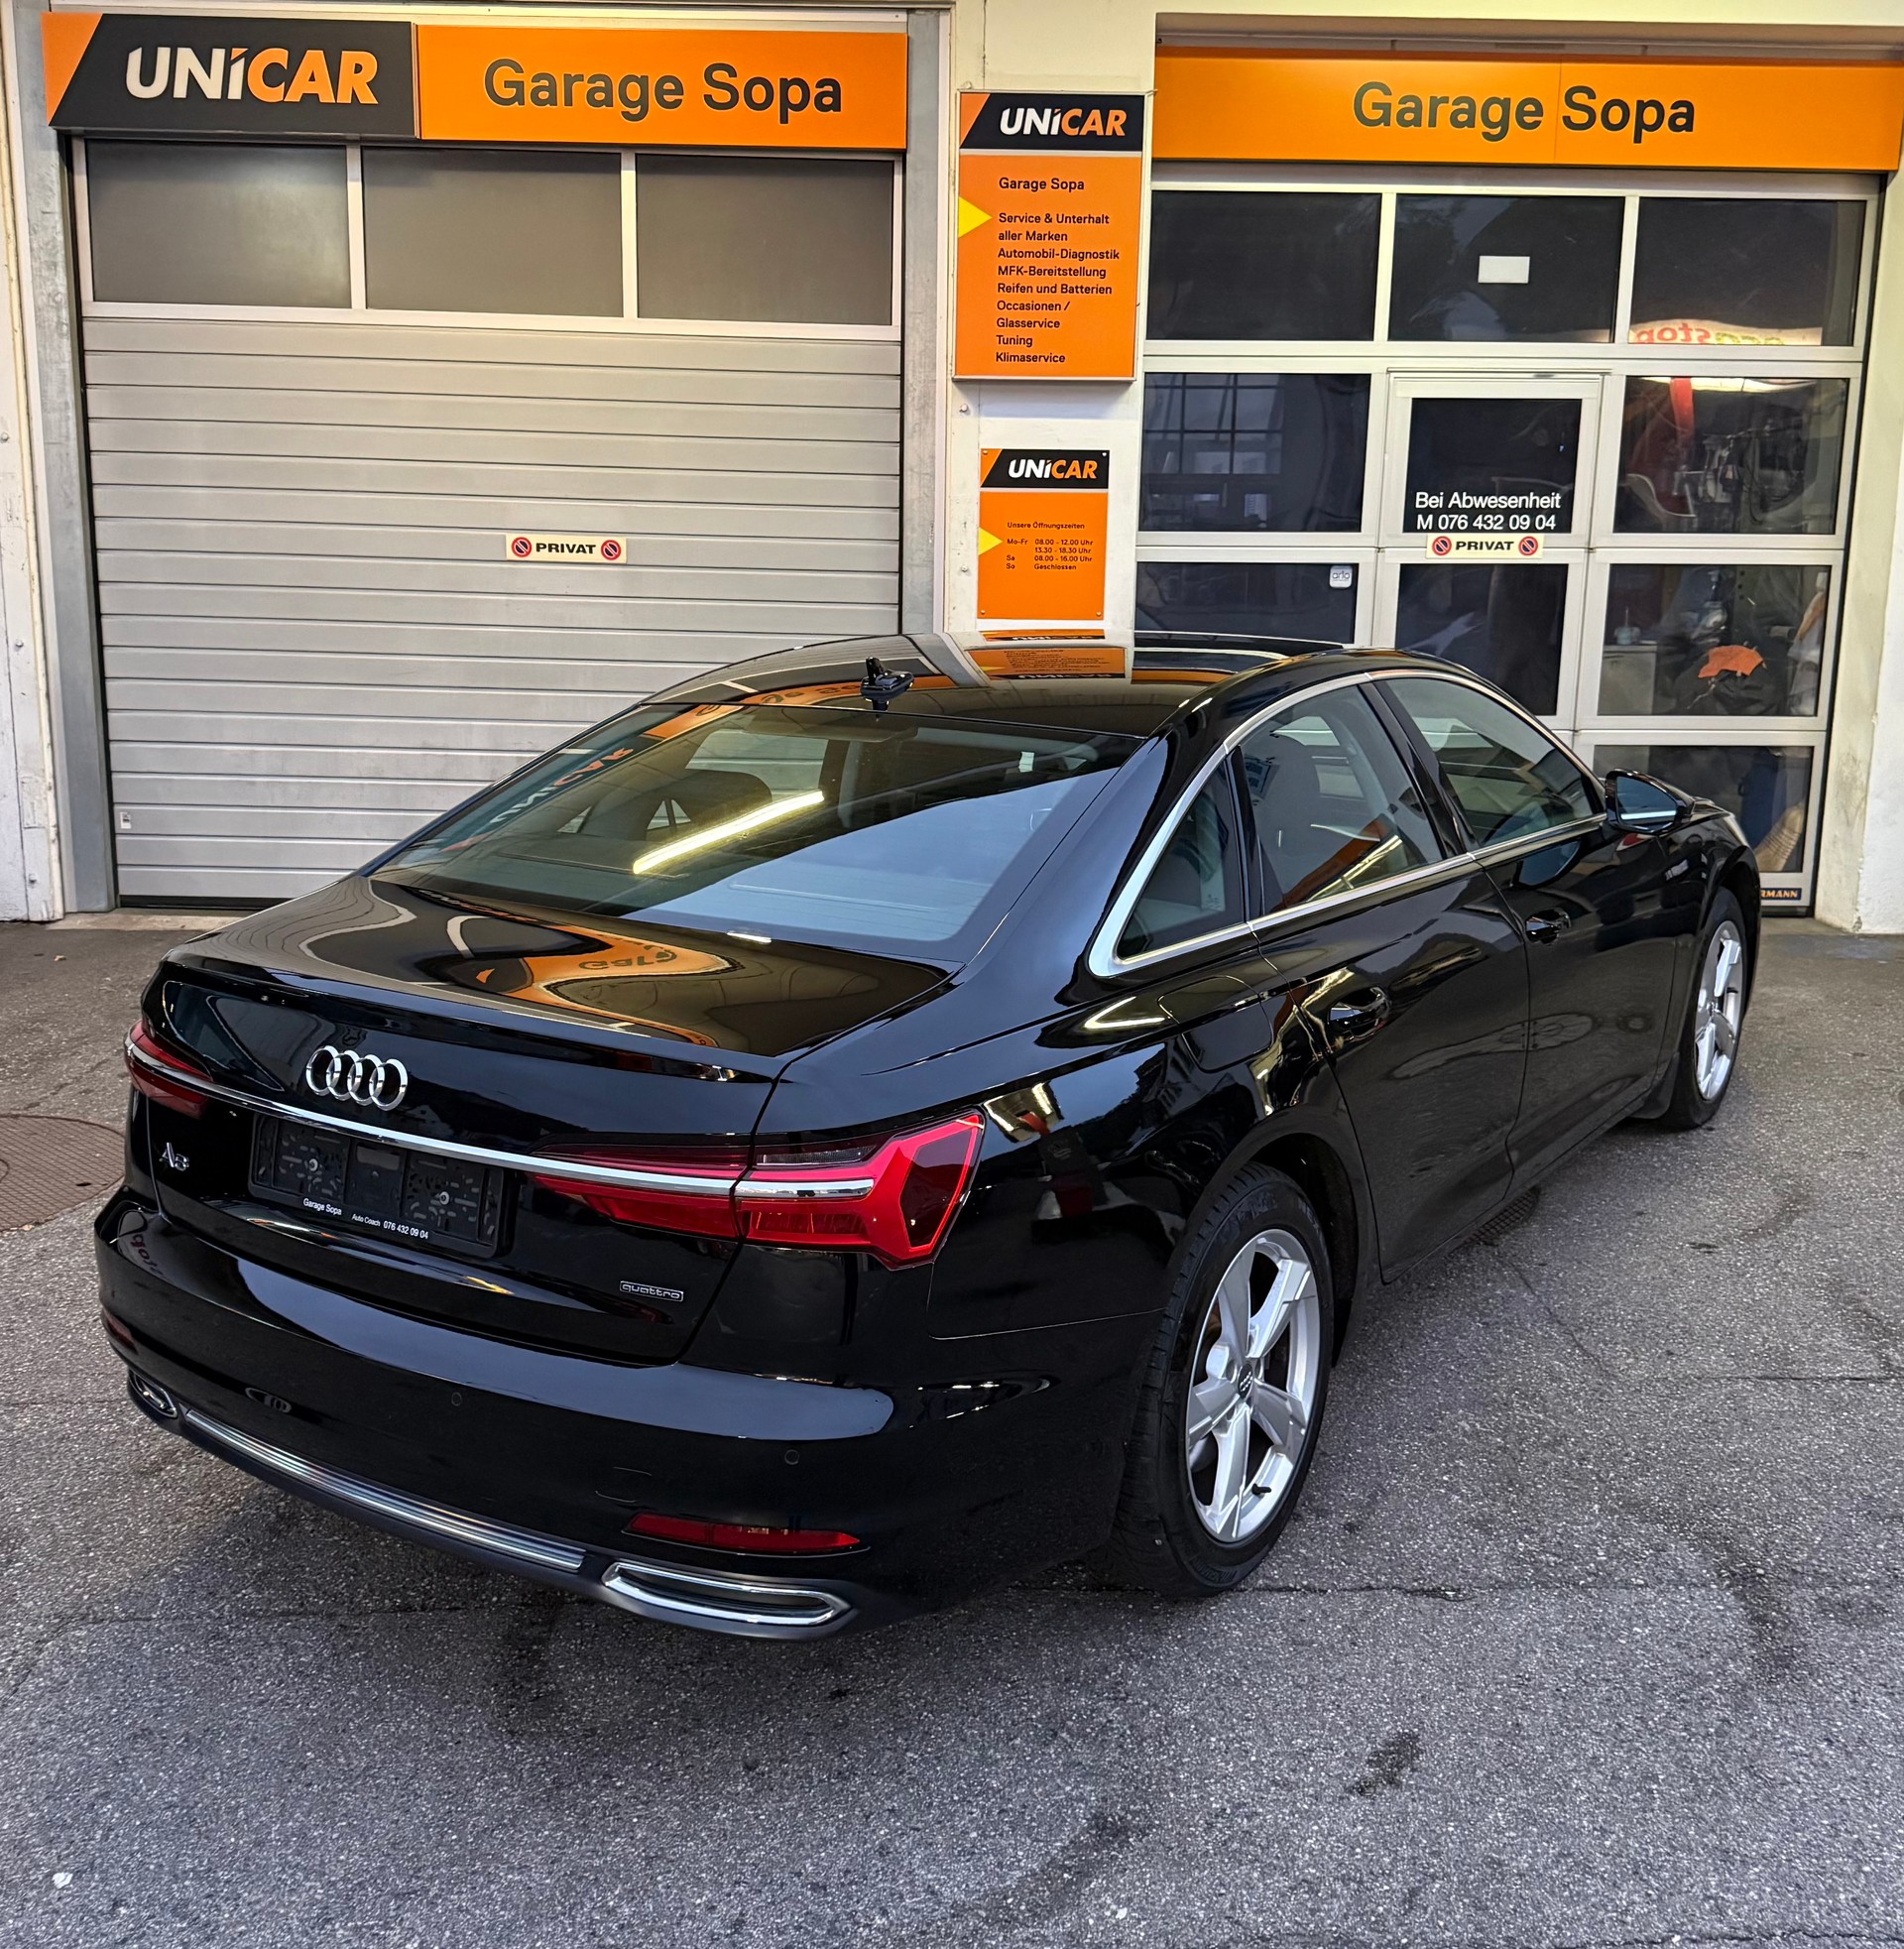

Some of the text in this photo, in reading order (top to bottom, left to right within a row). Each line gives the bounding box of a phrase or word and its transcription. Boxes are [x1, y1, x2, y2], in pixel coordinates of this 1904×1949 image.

[483, 58, 843, 124] Garage Sopa
[1353, 81, 1696, 143] Garage Sopa
[999, 178, 1085, 192] Garage Sopa
[999, 212, 1110, 224] Service & Unterhalt
[998, 231, 1068, 241] aller Marken
[998, 248, 1120, 261] Automobil-Diagnostik
[998, 266, 1107, 279] MFK-Bereitstellung
[998, 283, 1112, 295] Reifen und Batterien
[997, 301, 1070, 311] Occasionen /
[997, 317, 1060, 328] Glasservice
[996, 335, 1033, 347] Tuning
[996, 352, 1066, 363] Klimaservice
[1415, 491, 1561, 508] Bei Abwesenheit
[1417, 514, 1557, 530] M 076 432 09 04
[536, 543, 596, 554] PRIVAT
[1455, 541, 1514, 550] PRIVAT
[303, 1197, 342, 1216] Garage Sopa
[351, 1213, 428, 1239] Auto Coach 076 432 09 04
[622, 1283, 680, 1299] quattro
